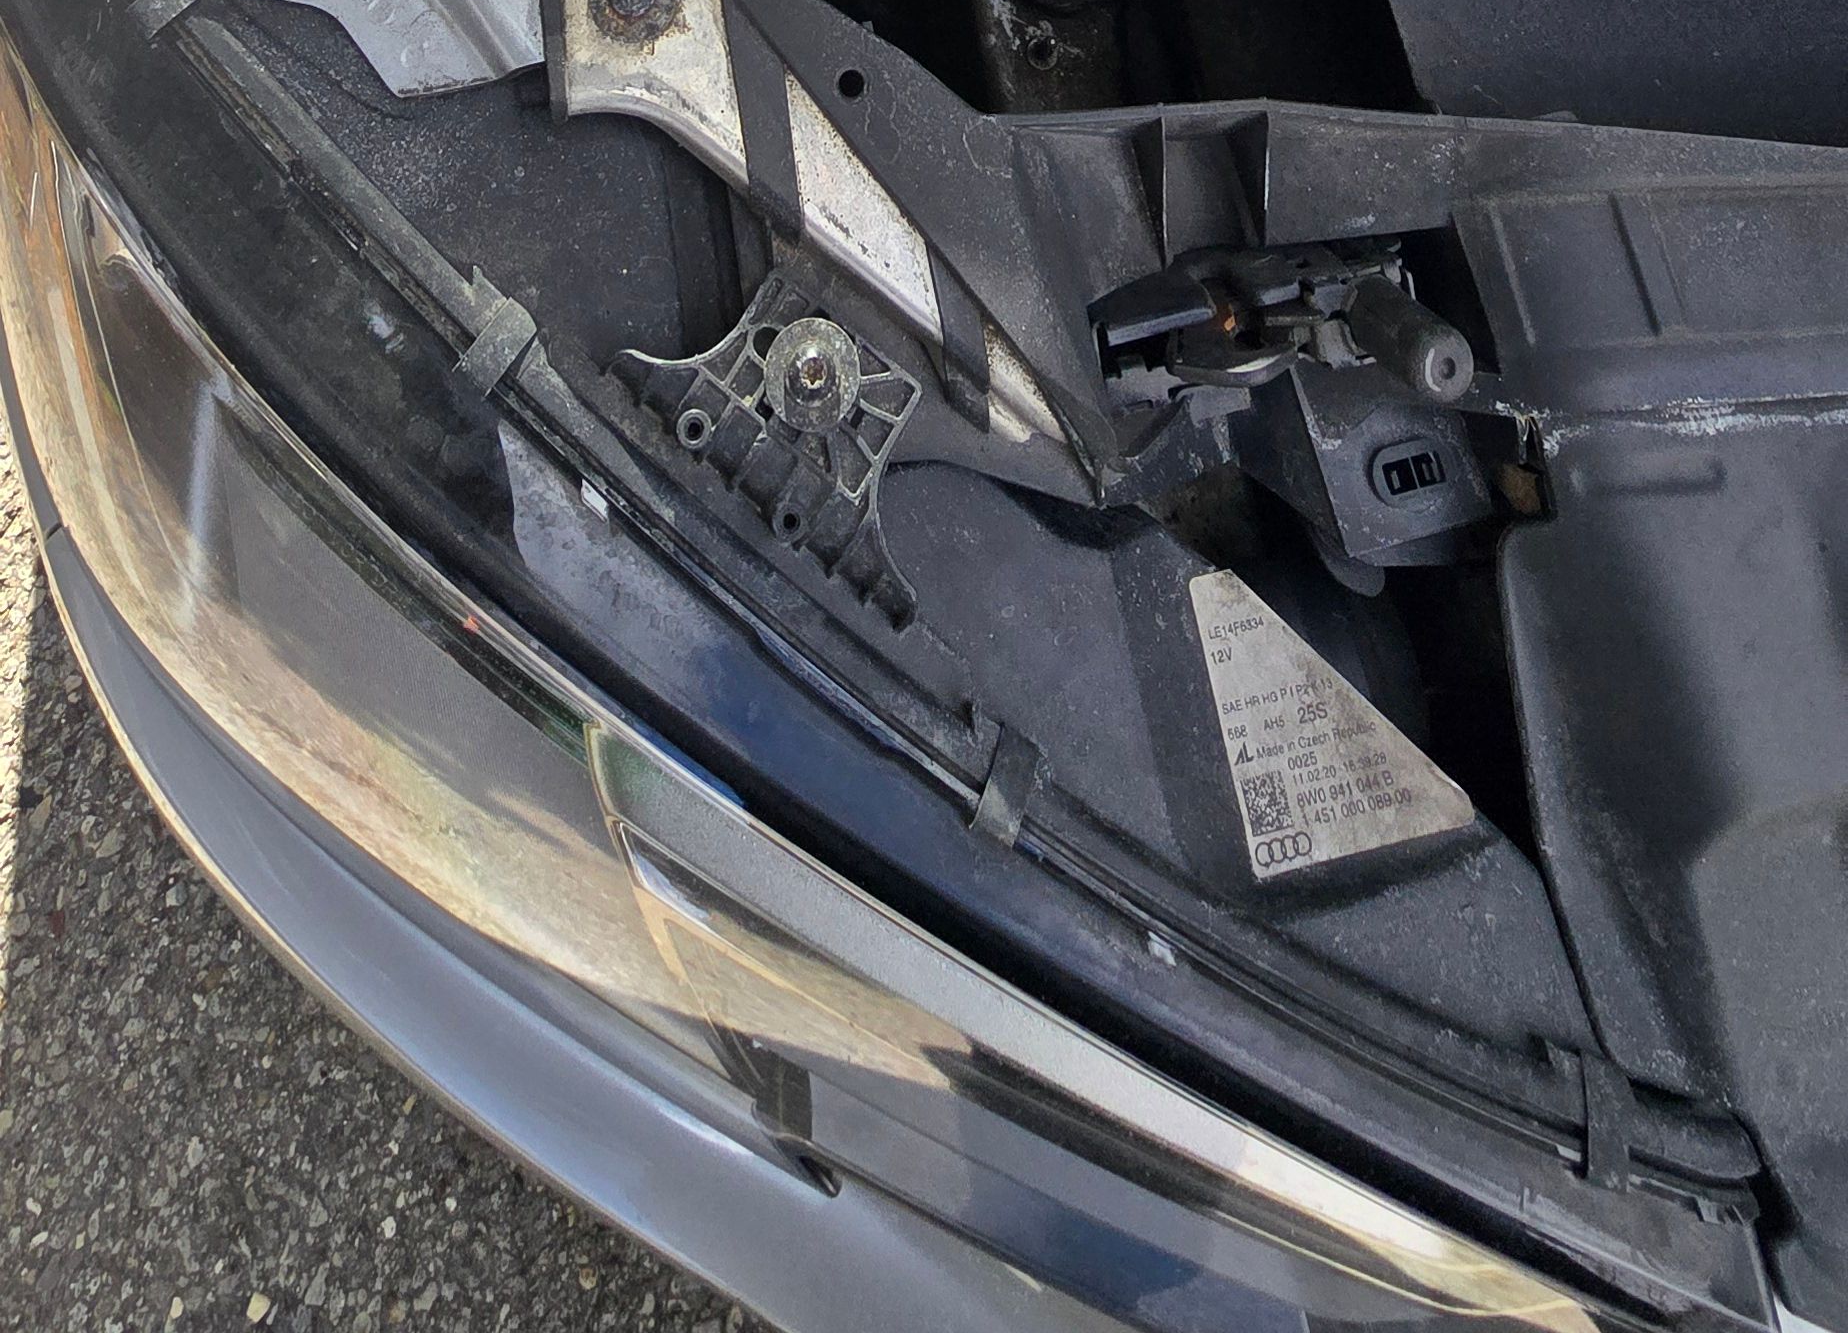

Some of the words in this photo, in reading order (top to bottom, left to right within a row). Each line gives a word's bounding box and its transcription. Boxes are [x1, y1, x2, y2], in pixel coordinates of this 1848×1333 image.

[1210, 647, 1232, 665] 12V
[1221, 699, 1243, 715] SAE
[1244, 695, 1260, 709] HR
[1297, 701, 1328, 724] 25S
[1256, 743, 1284, 759] Made
[1286, 740, 1296, 752] in
[1297, 731, 1331, 749] Czech
[1331, 721, 1376, 741] Republic
[1296, 787, 1327, 809] 8W0
[1329, 780, 1353, 801] 941
[1381, 770, 1394, 786] B
[1314, 805, 1337, 824] 451
[1340, 799, 1366, 819] 000
